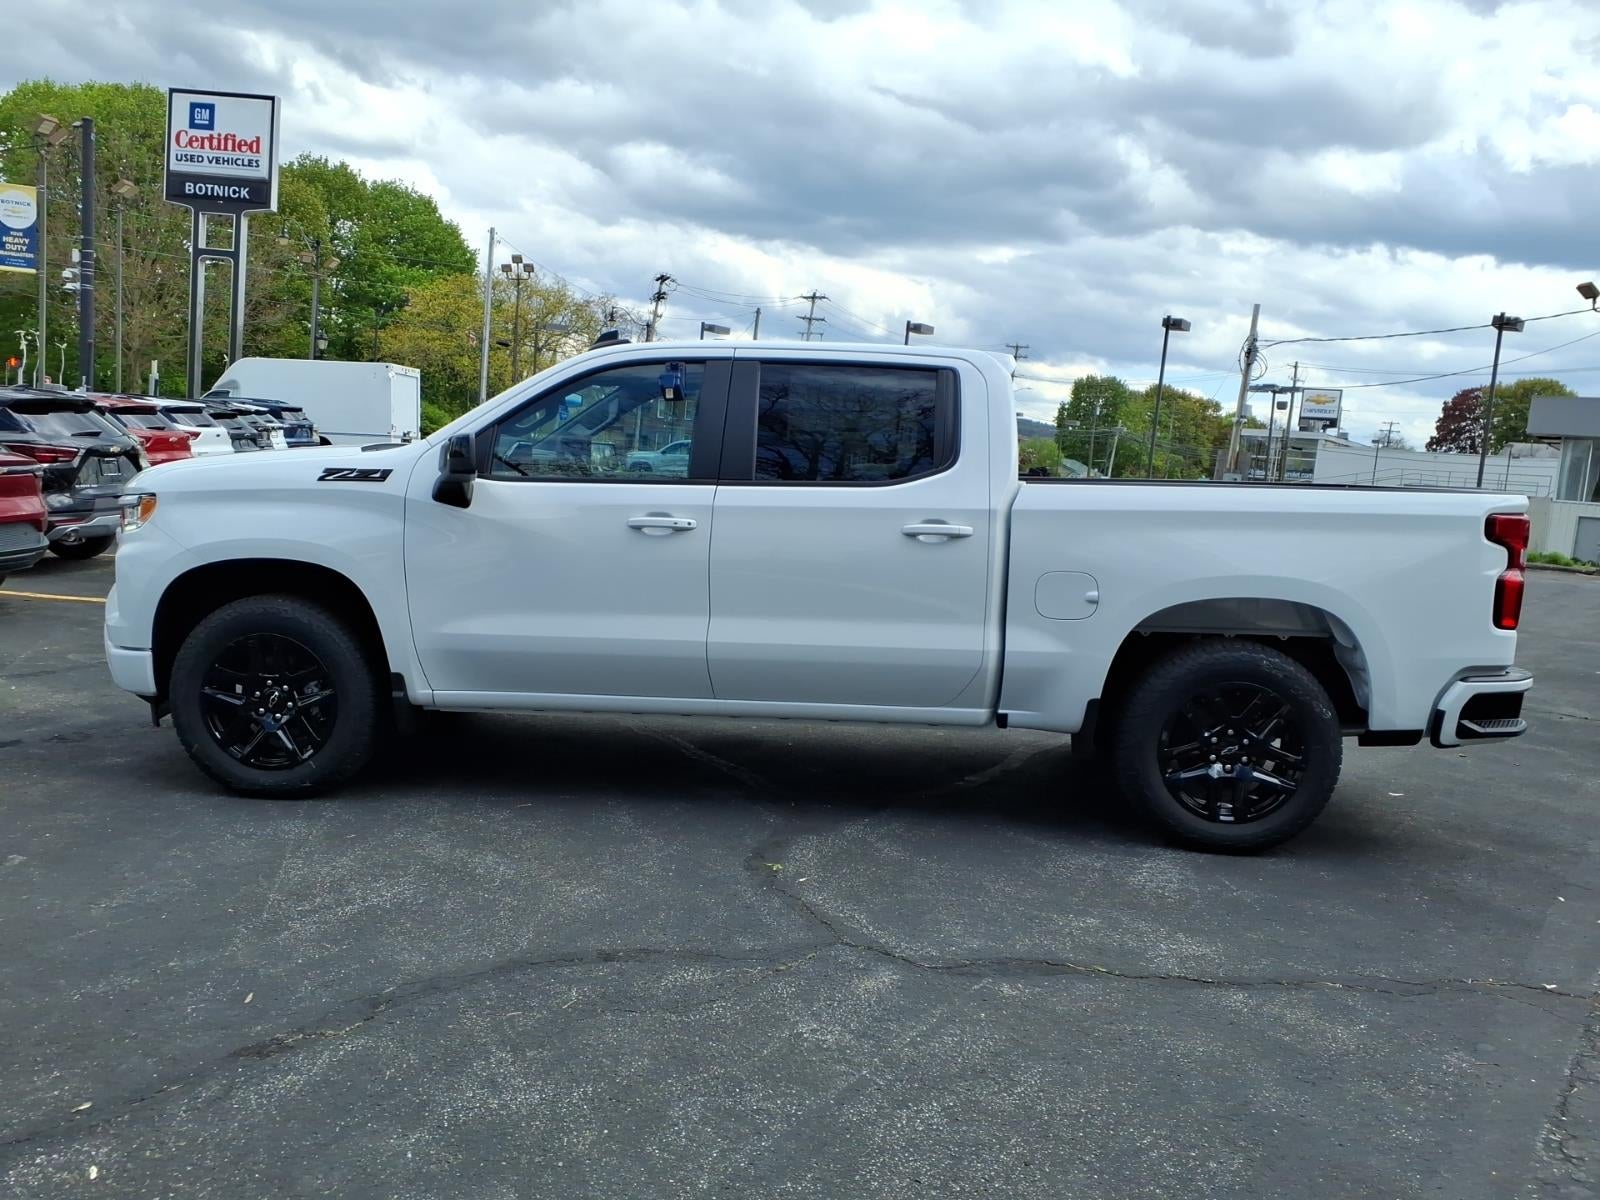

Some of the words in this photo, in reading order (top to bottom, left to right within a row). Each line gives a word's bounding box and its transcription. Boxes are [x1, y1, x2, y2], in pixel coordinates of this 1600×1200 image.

[194, 108, 210, 120] GM
[175, 129, 261, 154] Certified
[175, 153, 204, 164] USED
[207, 155, 260, 168] VEHICLES
[185, 182, 250, 199] BOTNICK
[2, 236, 30, 245] HEAVY
[5, 243, 27, 252] DUTY
[316, 467, 394, 482] Z71
